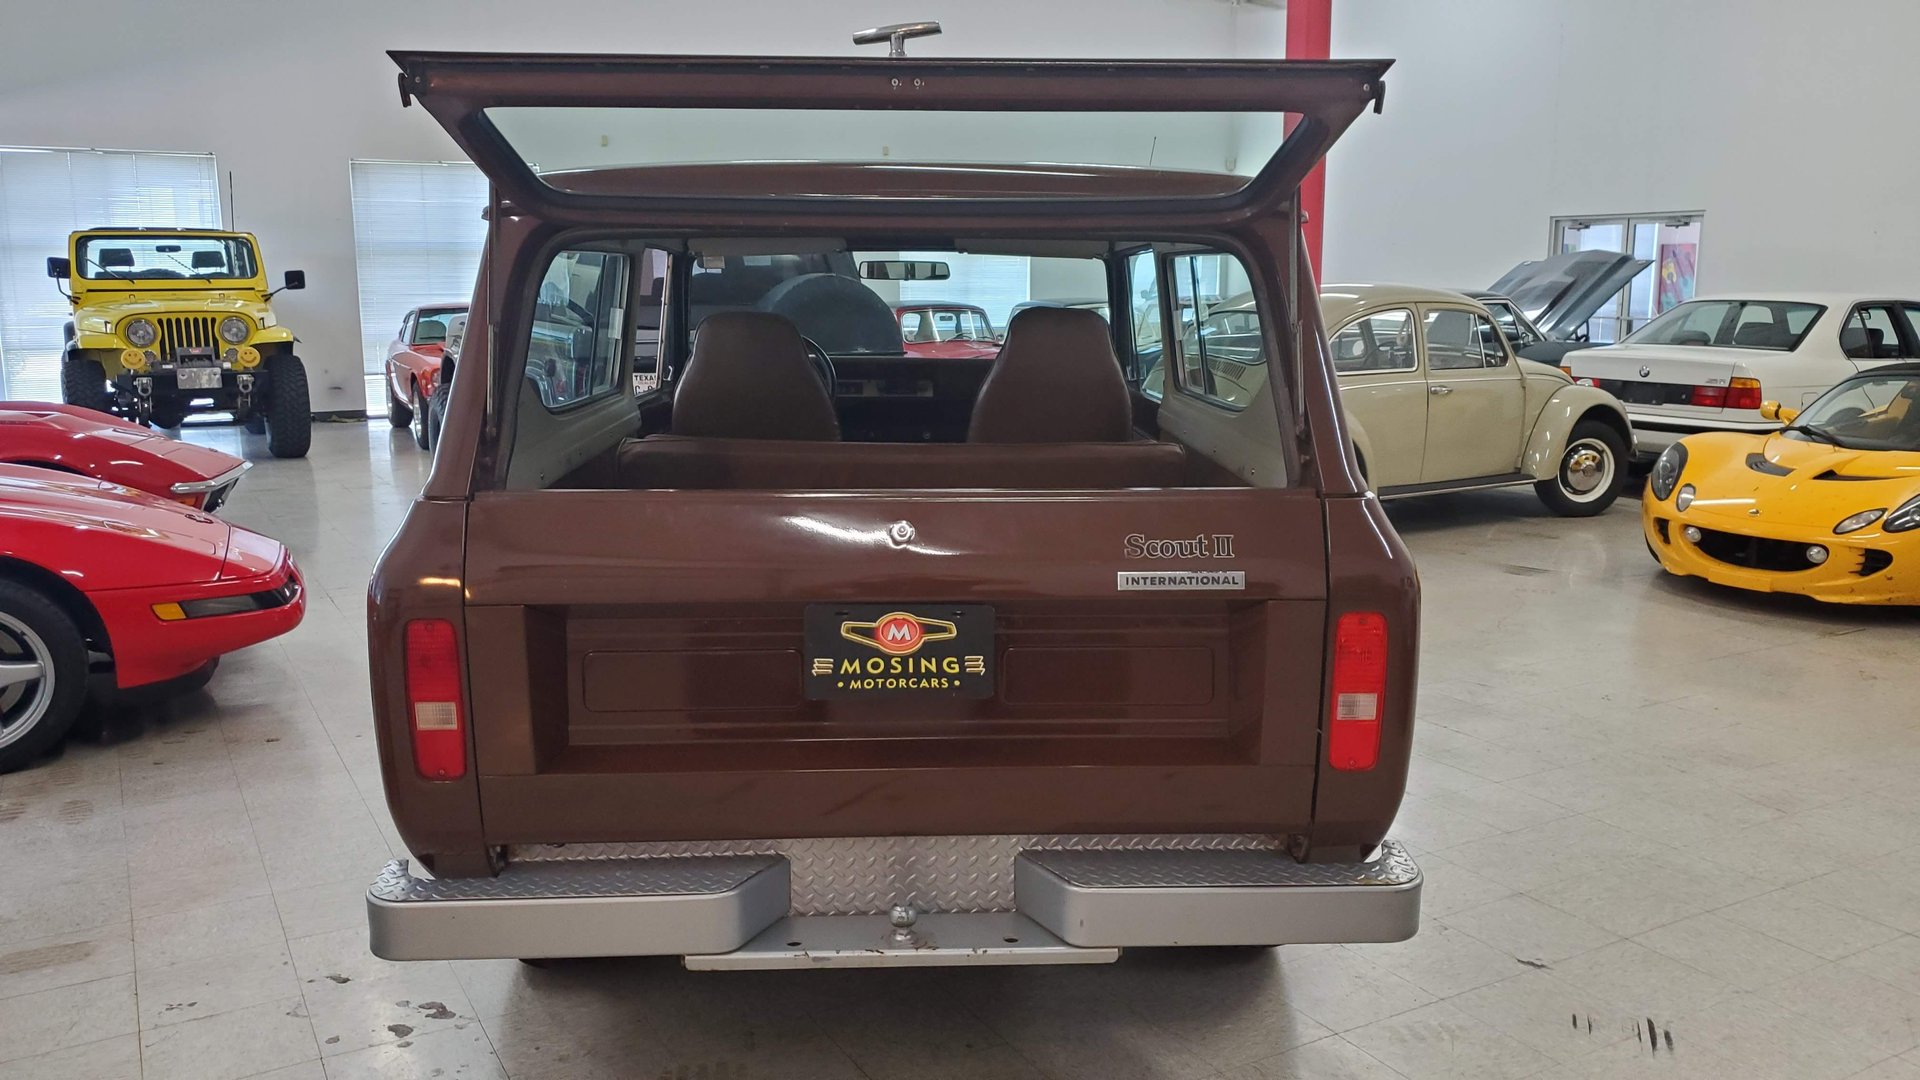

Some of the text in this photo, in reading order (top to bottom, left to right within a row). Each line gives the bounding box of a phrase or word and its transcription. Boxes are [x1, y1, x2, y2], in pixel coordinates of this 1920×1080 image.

[1124, 533, 1235, 558] Scout II
[1125, 575, 1239, 586] INTERNATIONAL
[887, 623, 911, 641] M
[840, 657, 960, 674] MOSING
[849, 678, 949, 689] MOTORCARS
